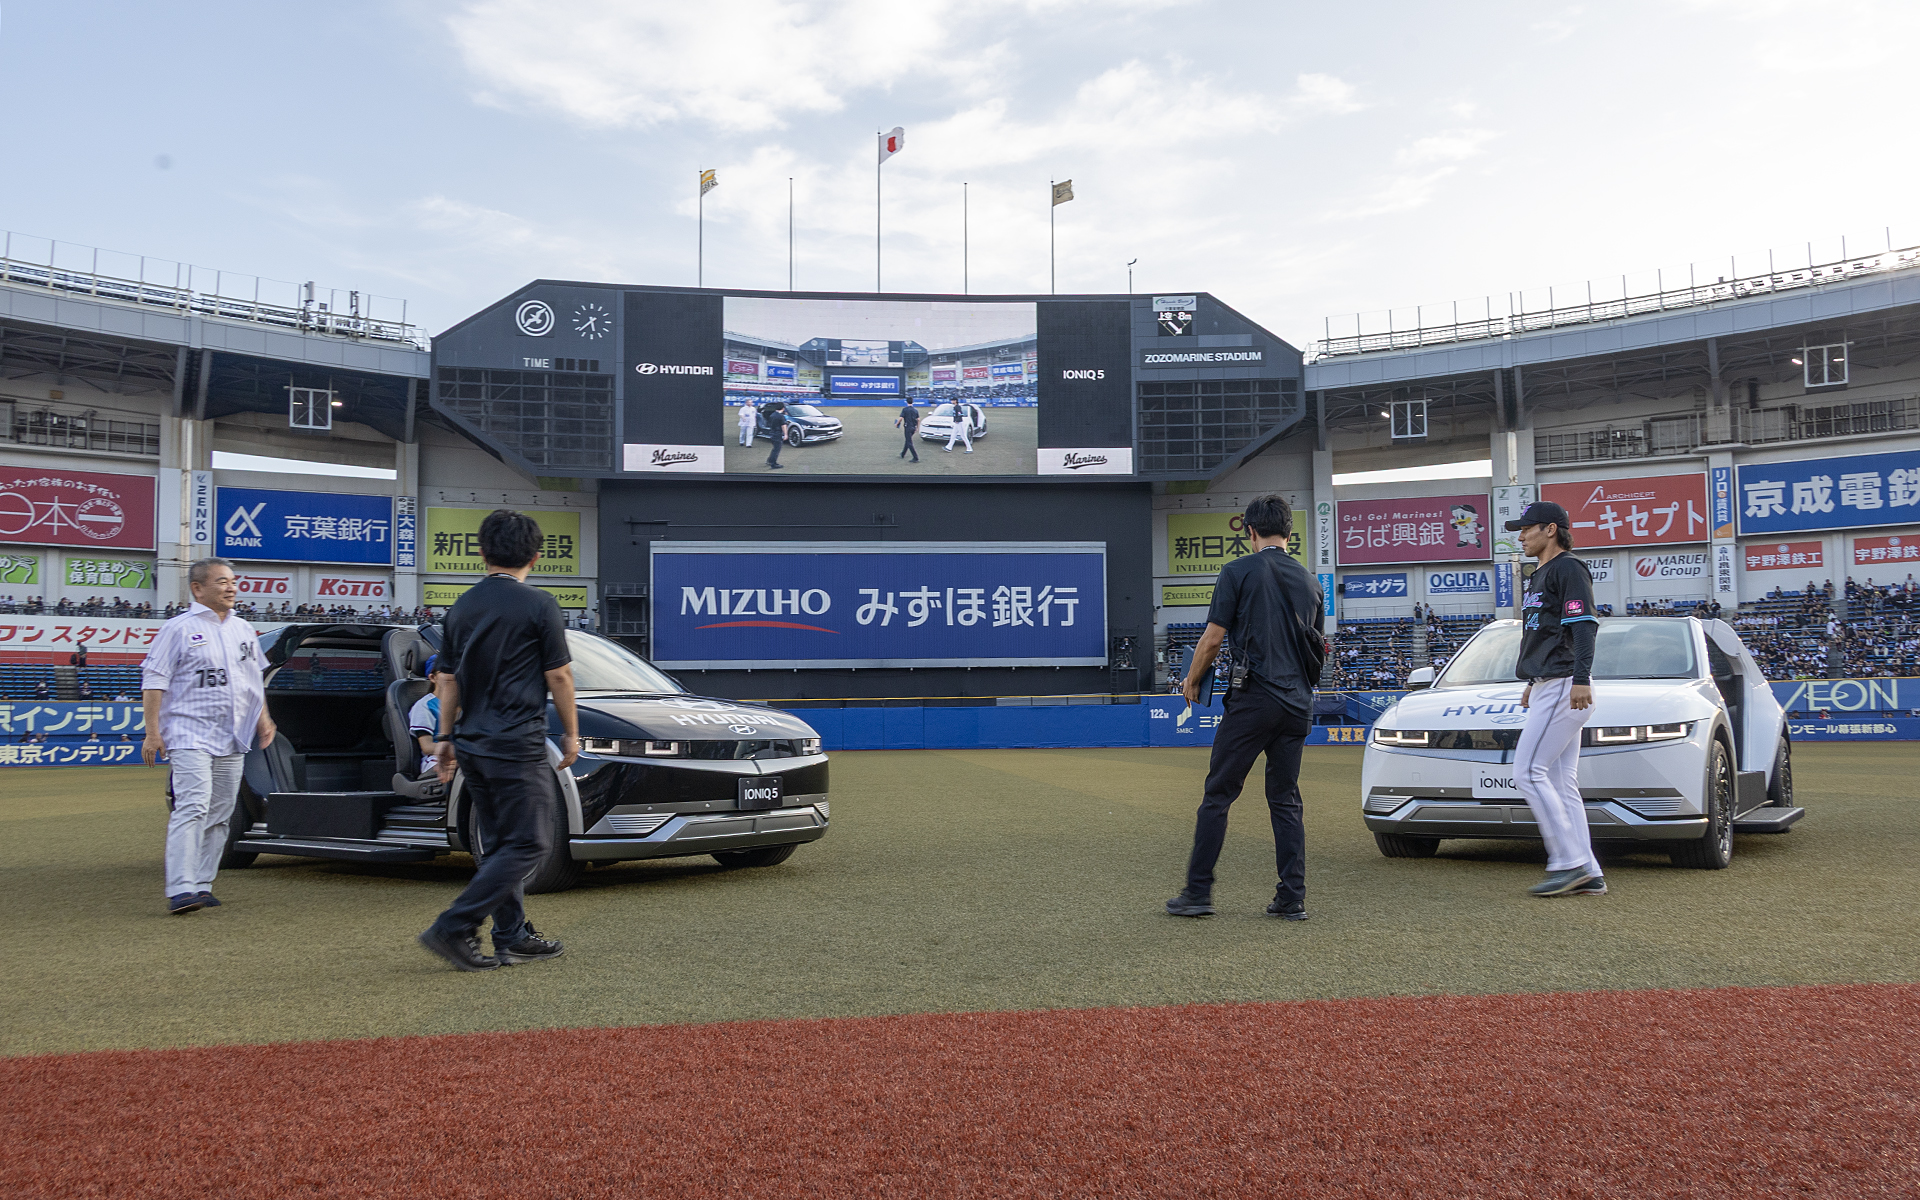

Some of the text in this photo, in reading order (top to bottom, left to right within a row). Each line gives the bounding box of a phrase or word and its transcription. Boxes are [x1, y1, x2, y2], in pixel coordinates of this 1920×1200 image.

[523, 357, 549, 368] TIME
[1215, 351, 1261, 362] STADIUM
[660, 364, 714, 376] HYUNDAI
[1063, 369, 1105, 380] IONIQ 5
[651, 449, 698, 465] Marines
[1063, 453, 1107, 469] Marines
[1606, 491, 1656, 500] ARCHICEPT
[1744, 467, 1920, 518] 京成電鉄
[1343, 510, 1443, 523] Go! Go! Marines!
[1566, 499, 1705, 541] ーキセプト
[283, 514, 389, 543] 京葉銀行
[1343, 521, 1446, 550] ちば興銀
[225, 537, 263, 547] BANK
[398, 515, 415, 566] 大森工業
[1656, 554, 1707, 566] MARUEI
[1856, 545, 1920, 562] 宇野澤鉄
[70, 559, 126, 574] そらまめ
[434, 562, 573, 573] INTELLIG ELOPER
[1585, 558, 1613, 570] RUEI
[69, 572, 115, 585] 保育園
[1661, 566, 1701, 577] Group
[1366, 579, 1406, 594] オグラ
[1430, 572, 1489, 588] OGURA
[680, 586, 832, 616] MIZUHO
[1164, 591, 1205, 601] EXCELLENT
[855, 585, 1080, 628] みずほ銀行
[196, 668, 227, 688] 753
[1442, 704, 1530, 717] HYUN
[670, 713, 783, 726] HYUNDAI
[0, 744, 135, 765] 東京インテリア
[744, 787, 779, 801] IONIQ 5
